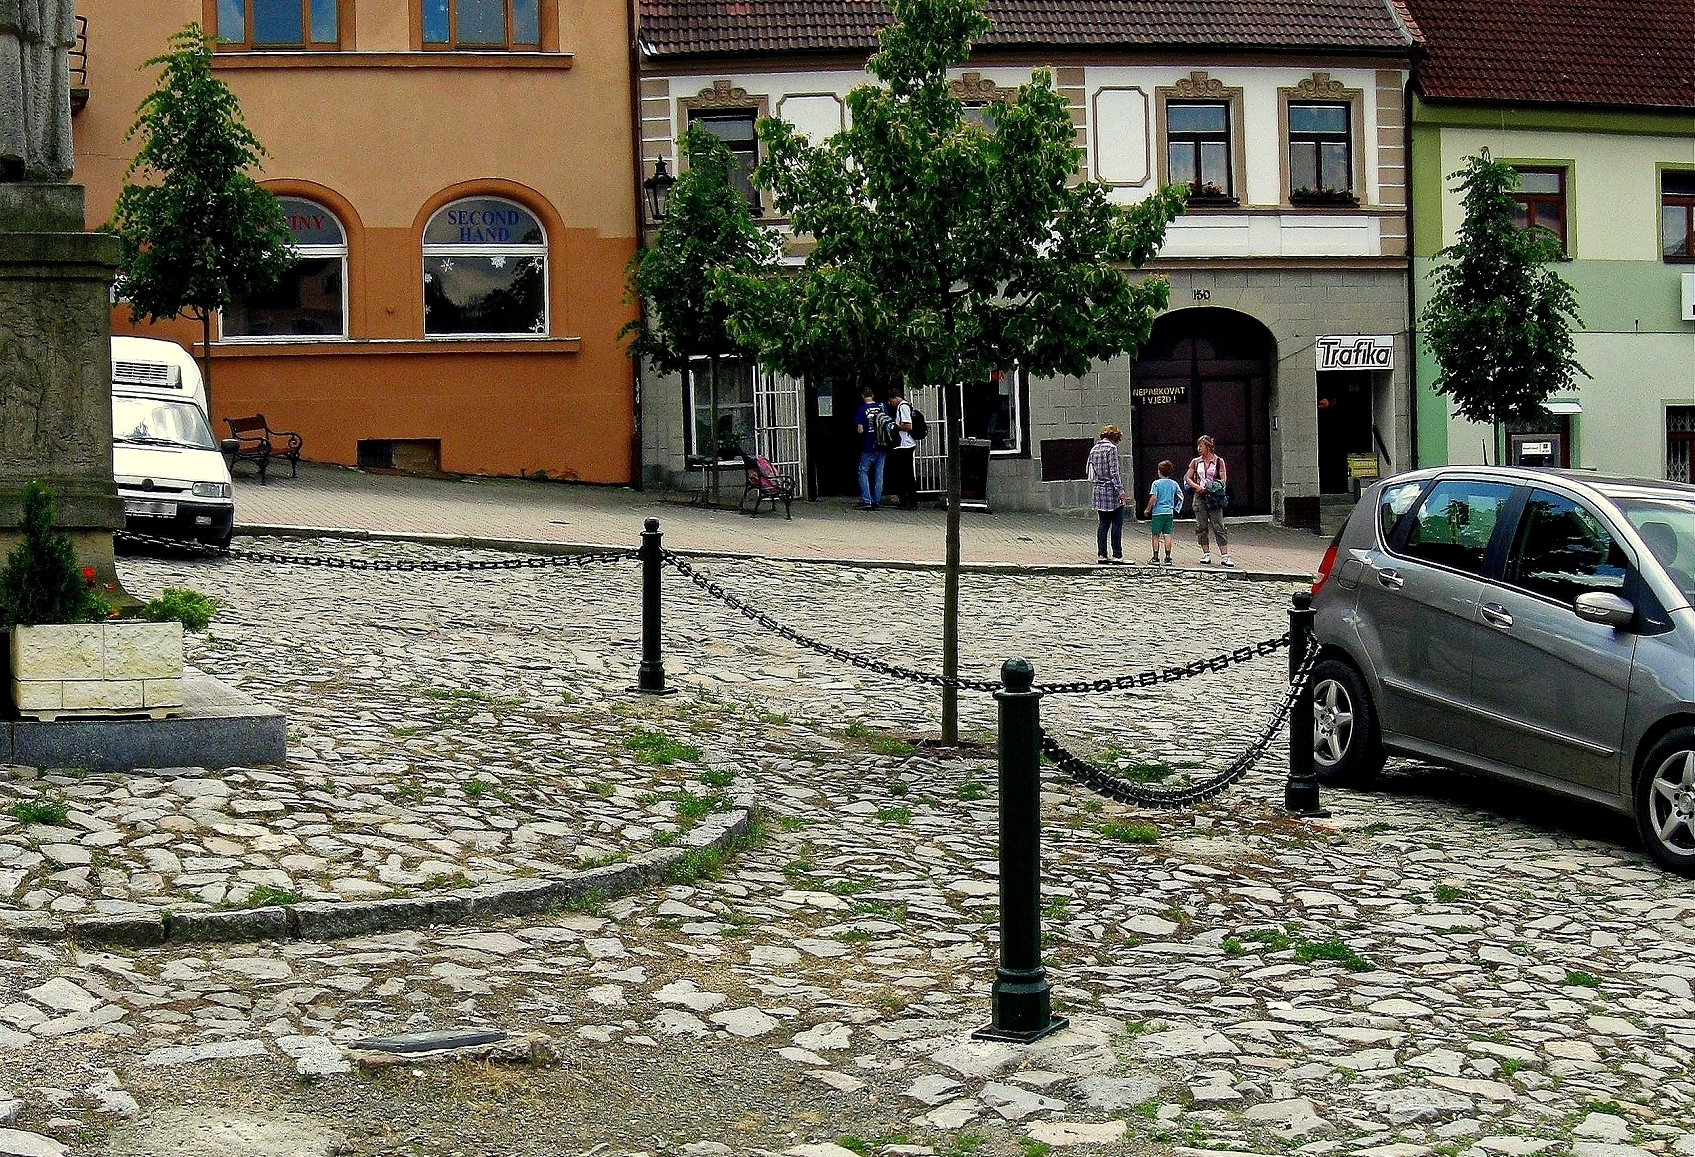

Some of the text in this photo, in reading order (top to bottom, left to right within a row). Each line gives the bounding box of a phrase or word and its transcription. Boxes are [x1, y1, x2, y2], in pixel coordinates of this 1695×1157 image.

[448, 210, 519, 225] SECOND
[459, 227, 510, 242] HAND
[1193, 289, 1211, 301] 150
[1318, 340, 1391, 366] Trafika
[1132, 386, 1186, 396] NEPARKOVAT
[1147, 395, 1172, 405] VJEZD
